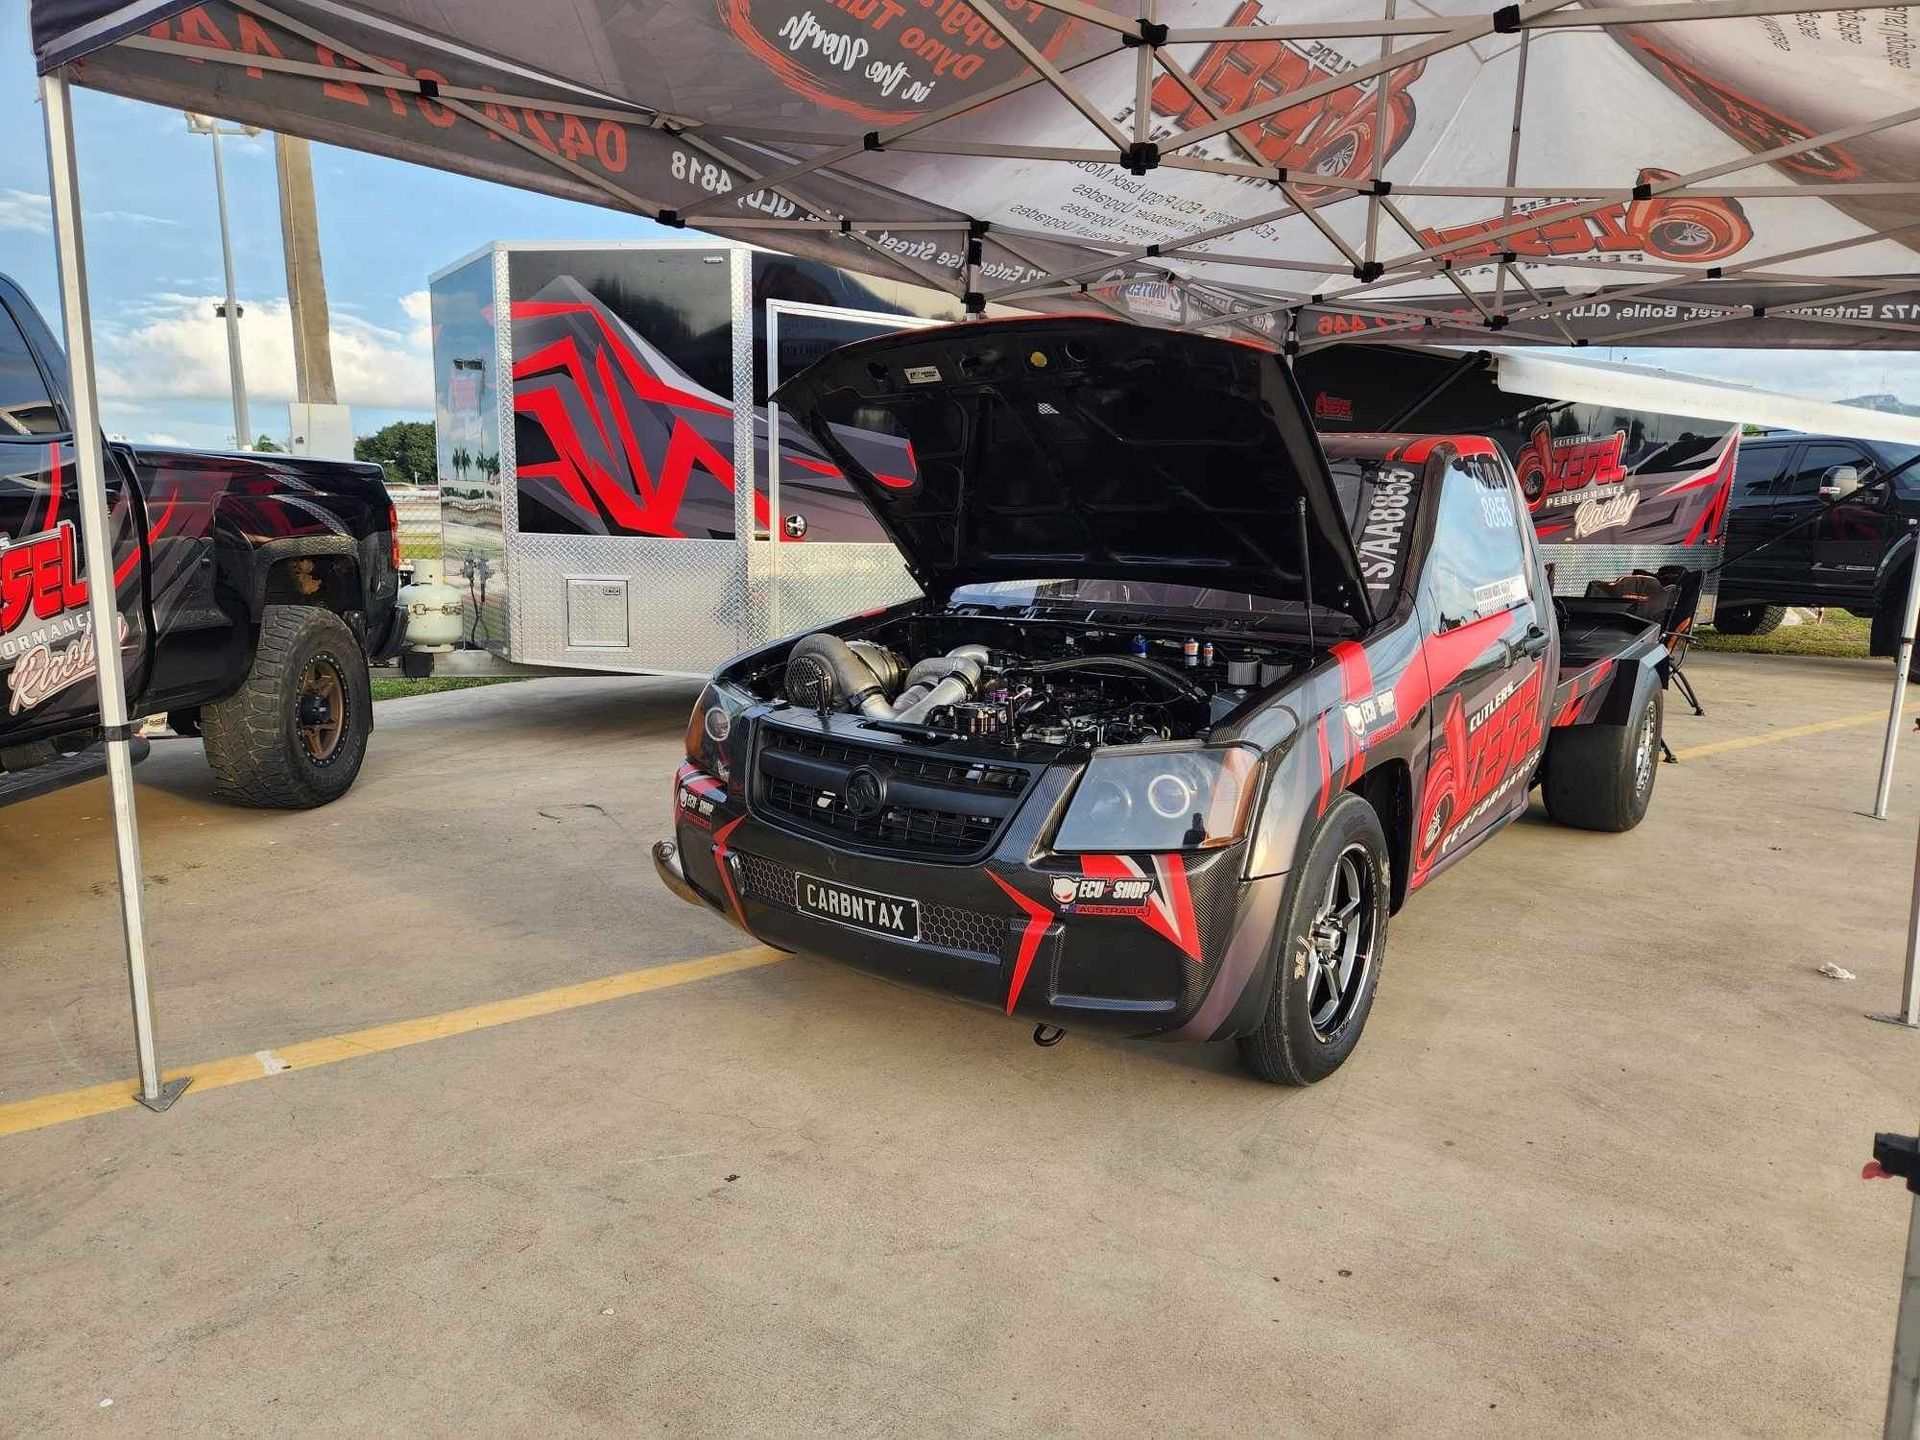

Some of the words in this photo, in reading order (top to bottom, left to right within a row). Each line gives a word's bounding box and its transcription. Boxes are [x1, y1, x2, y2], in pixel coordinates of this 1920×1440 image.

[1545, 484, 1626, 508] PERFORMANCE
[1574, 489, 1641, 540] Racing
[1469, 683, 1515, 733] CUTLERS
[1441, 749, 1543, 854] PERFORMANCE
[805, 882, 905, 932] CARBNTAX
[1079, 906, 1145, 916] AUSTRALIA
[1111, 881, 1150, 900] SHOP
